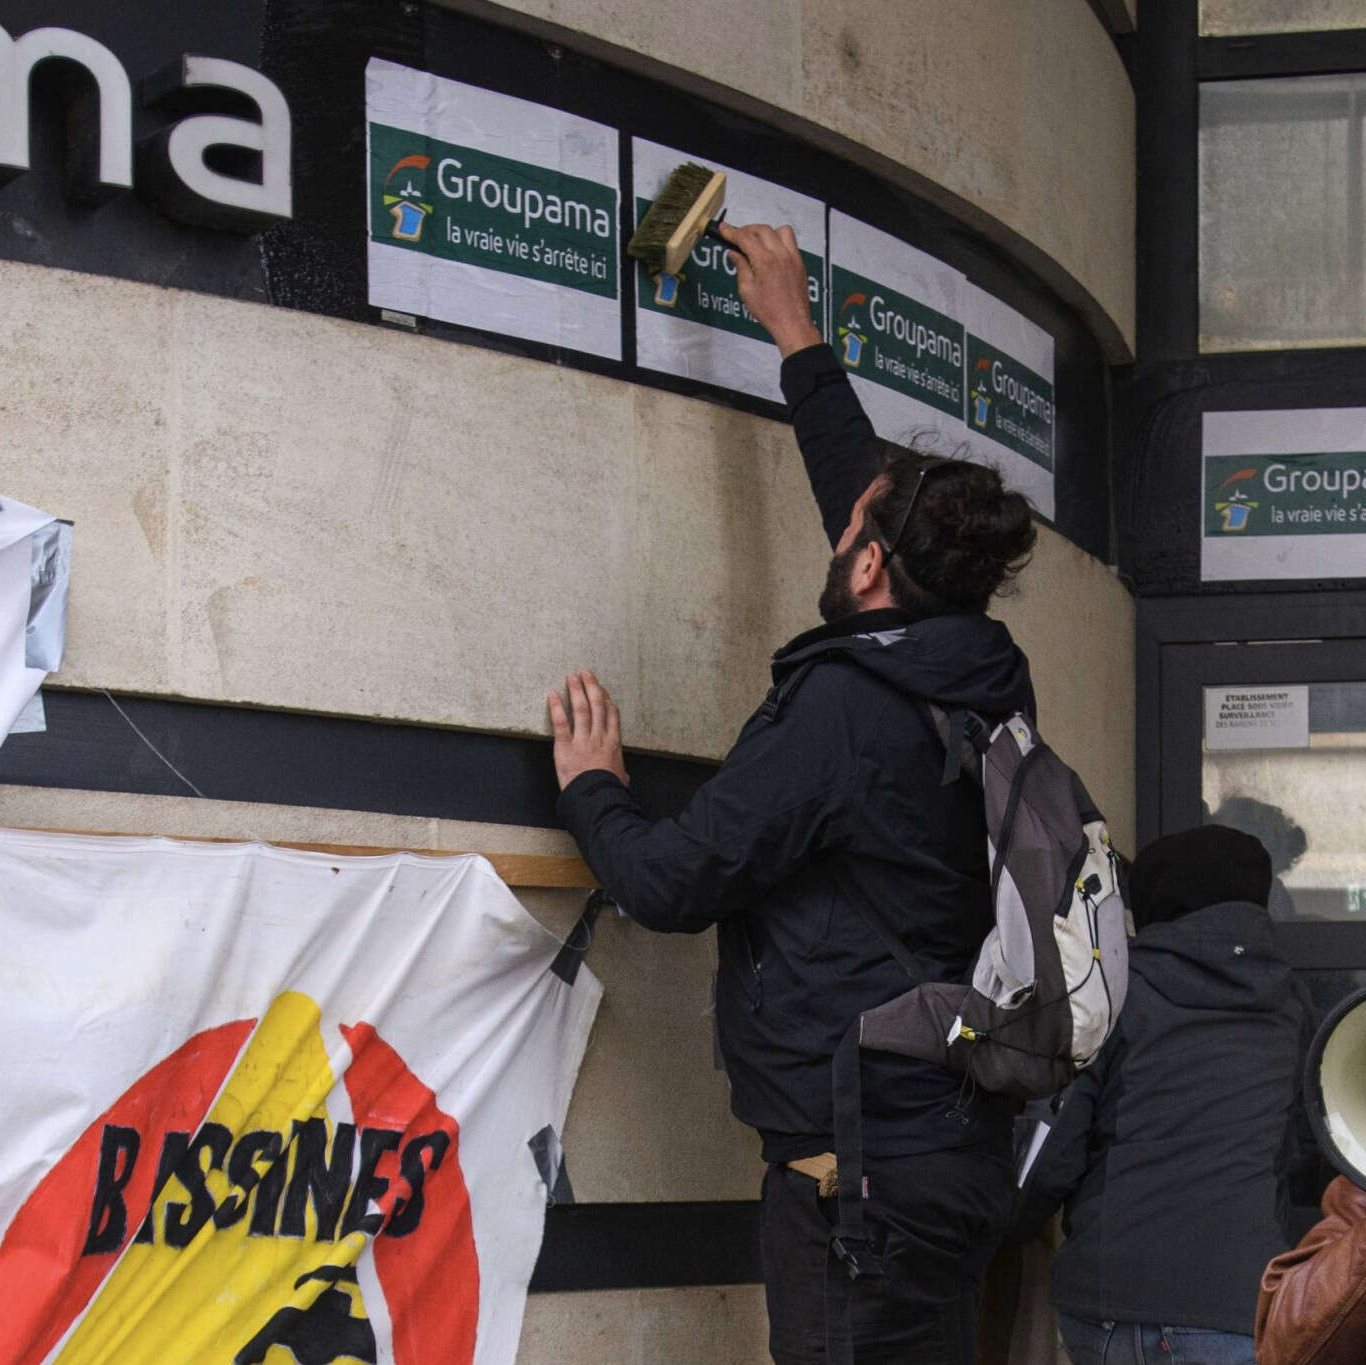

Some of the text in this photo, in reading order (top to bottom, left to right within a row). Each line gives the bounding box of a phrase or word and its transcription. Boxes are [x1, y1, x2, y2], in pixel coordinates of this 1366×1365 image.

[436, 158, 610, 237] Groupama
[446, 216, 462, 244] la
[464, 228, 503, 254] vraie
[506, 234, 529, 260] vie
[591, 253, 607, 280] ici
[697, 282, 708, 308] la
[710, 293, 740, 317] vraie
[869, 296, 962, 367] Groupama
[874, 345, 884, 369] la
[885, 353, 906, 379] vraie
[992, 361, 1052, 424] Groupama
[1271, 505, 1284, 524] la
[1287, 505, 1322, 523] vraie
[1325, 504, 1346, 522] vie
